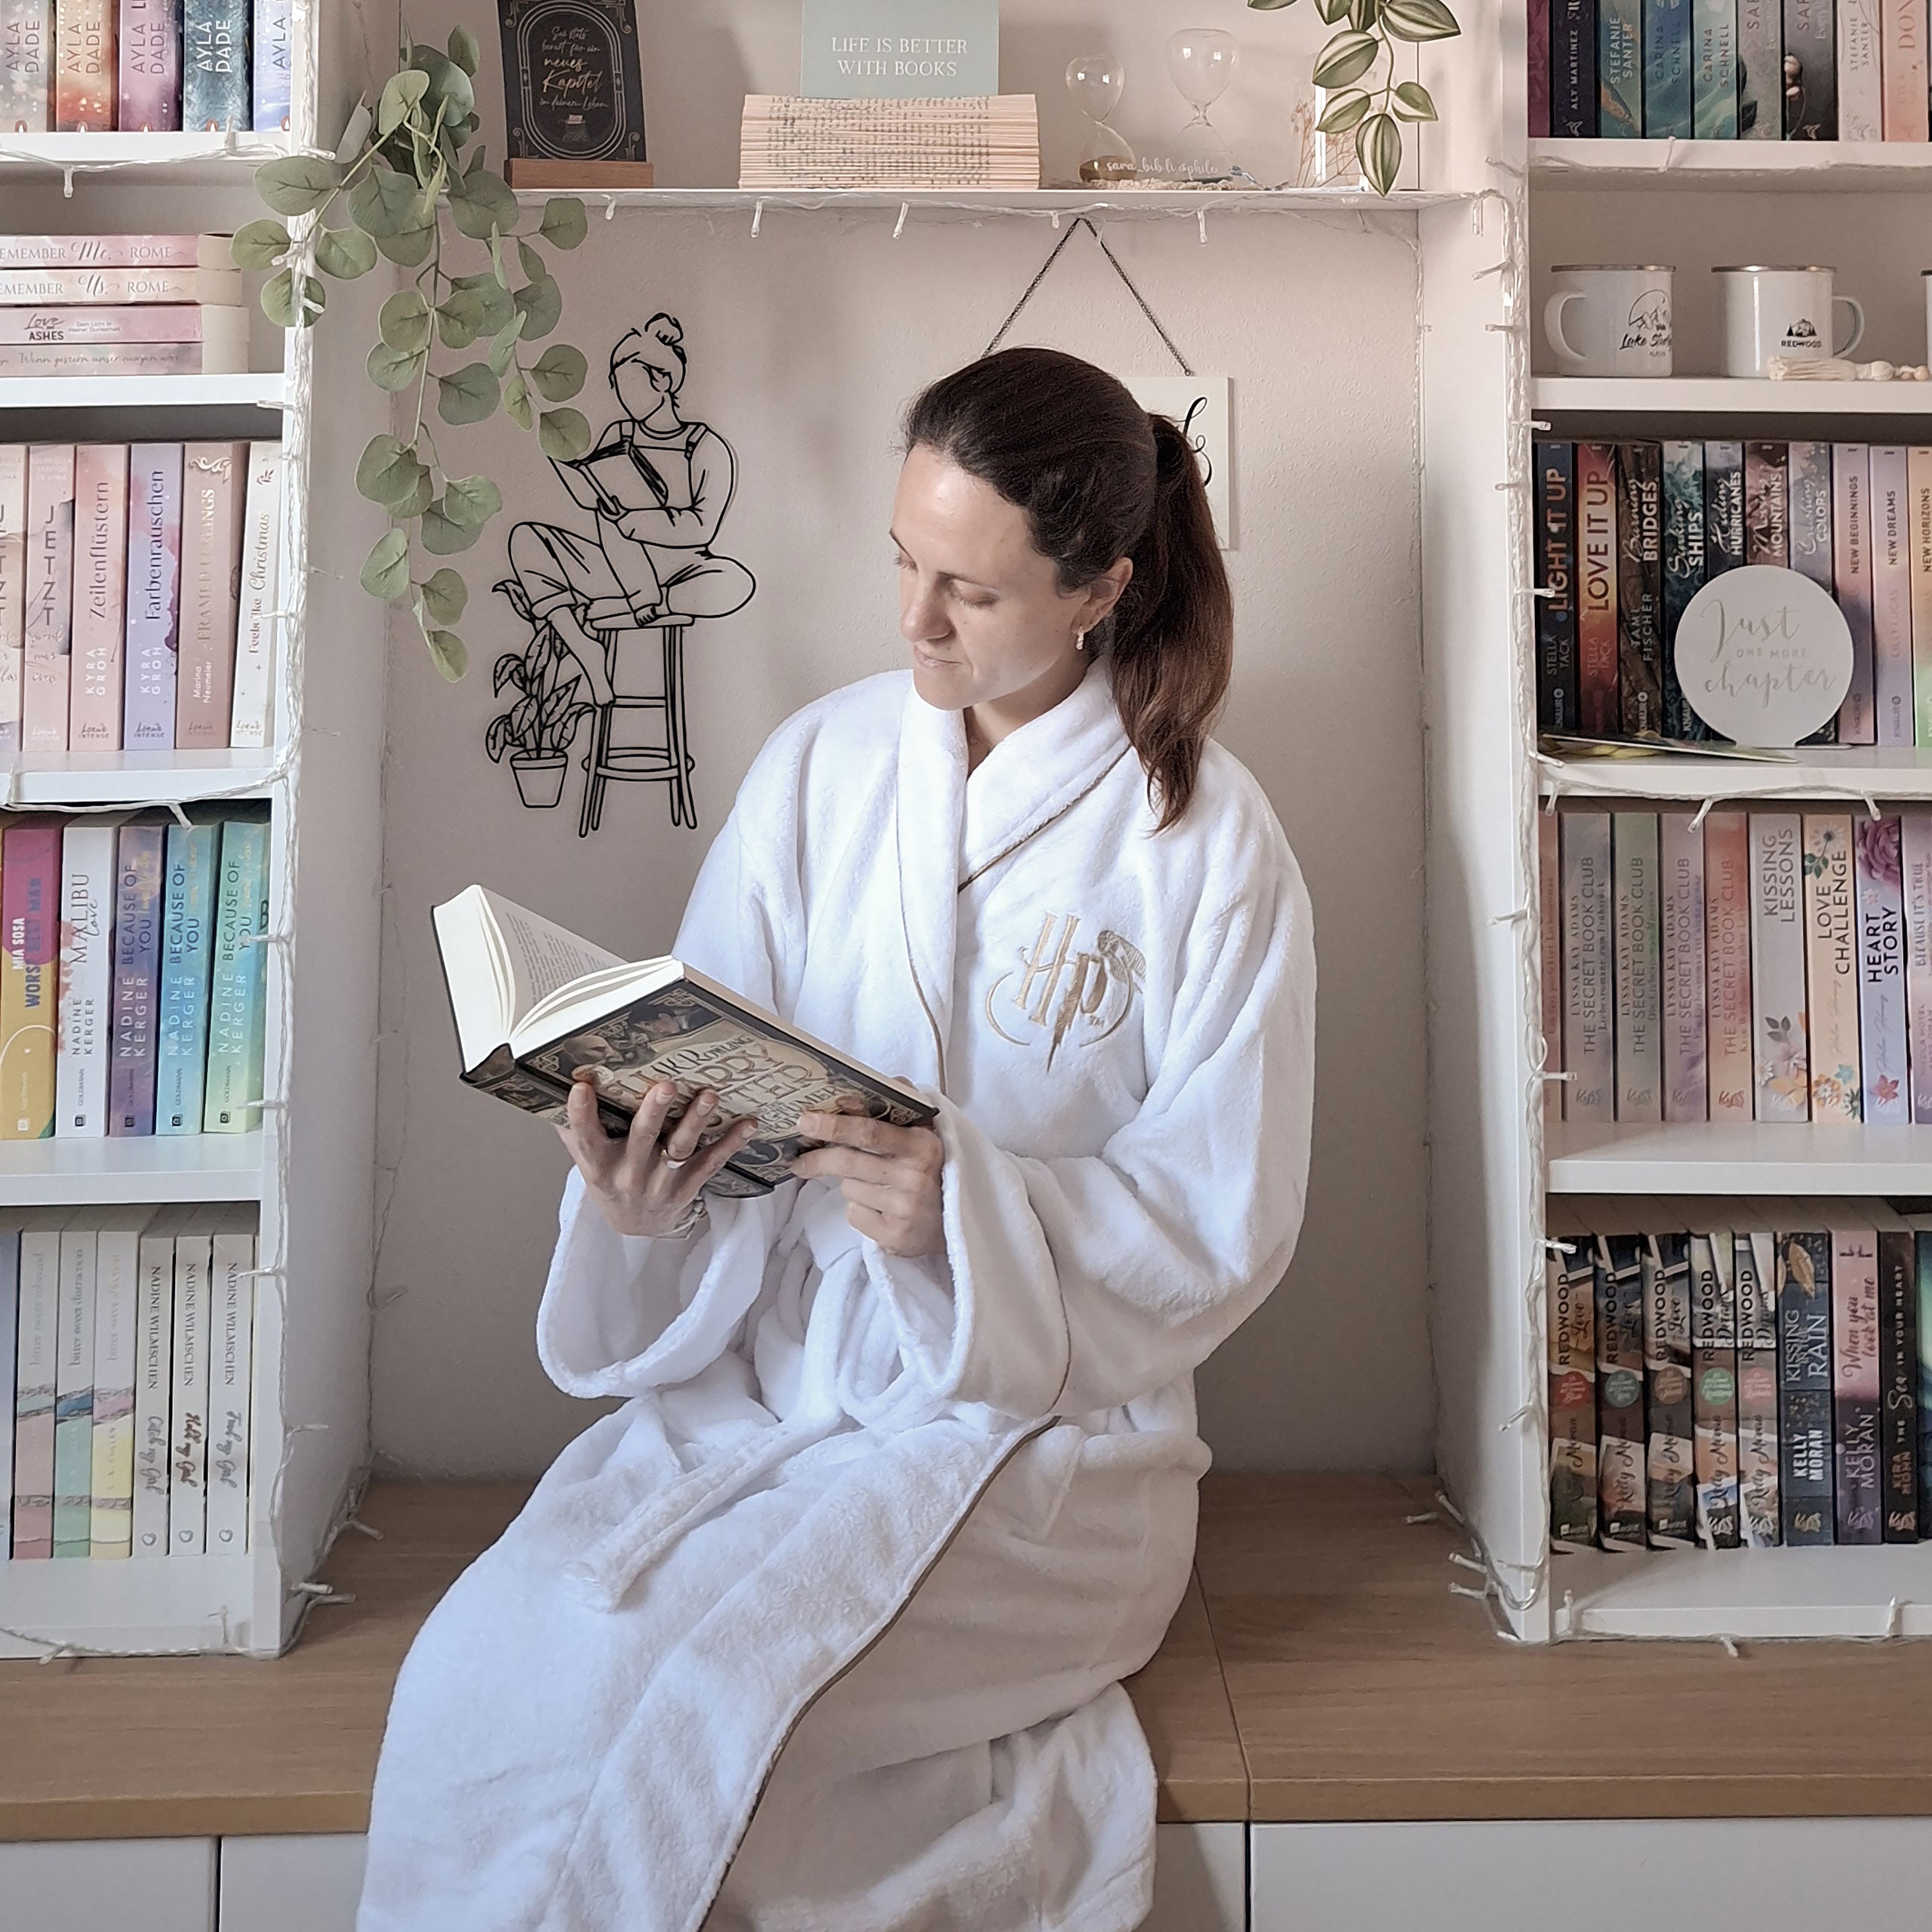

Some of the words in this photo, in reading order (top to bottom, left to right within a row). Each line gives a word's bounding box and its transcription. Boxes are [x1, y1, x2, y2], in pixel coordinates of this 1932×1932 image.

[5, 21, 20, 72] AYLA
[25, 20, 40, 72] DADE
[67, 23, 82, 73] AYLA
[86, 21, 100, 74] DADE
[131, 23, 145, 73] AYLA
[150, 22, 165, 74] DADE
[197, 20, 212, 73] AYLA
[216, 20, 232, 73] DADE
[272, 17, 286, 69] AYLA
[544, 58, 588, 72] neues
[832, 37, 869, 53] LIFE
[876, 38, 892, 53] IS
[900, 38, 968, 54] BETTER
[1570, 29, 1580, 92] MARTINEZ
[1610, 17, 1621, 85] STEFANIE
[1623, 23, 1634, 78] SANTER
[1654, 26, 1665, 79] CARINA
[1671, 22, 1681, 85] SCHNELL
[1703, 29, 1712, 82] CARINA
[1719, 25, 1729, 88] SCHNELL
[1861, 23, 1869, 66] SANTER
[543, 69, 603, 98] Kapitel
[837, 60, 887, 76] WITH
[894, 60, 957, 77] BOOKS
[1571, 94, 1579, 110] ALY
[0, 248, 66, 260] EMEMBER
[130, 246, 172, 259] ROME
[127, 280, 170, 293] ROME
[25, 313, 65, 330] Love
[29, 331, 64, 341] ASHES
[1546, 469, 1567, 500] UP
[1587, 470, 1608, 506] UP
[1587, 514, 1608, 534] IT
[1730, 471, 1743, 555] HURRICANES
[1770, 474, 1783, 557] MOUNTAINS
[1816, 490, 1827, 543] COLORS
[1849, 475, 1859, 545] BEGINNINGS
[1887, 491, 1897, 537] DREAMS
[1920, 488, 1930, 543] HORIZONS
[89, 481, 109, 620] Zeilenflüstern
[145, 470, 165, 620] Farbenrauschen
[249, 513, 270, 592] Christmas
[1664, 497, 1690, 579] Sinking
[1687, 512, 1704, 566] SHIPS
[1850, 549, 1860, 574] NEW
[1888, 540, 1898, 565] NEW
[1922, 547, 1931, 572] NEW
[43, 505, 57, 626] JETZT
[1546, 538, 1568, 611] LIGHT
[1587, 543, 1609, 611] LOVE
[249, 622, 260, 654] Feels
[1630, 608, 1641, 648] TAMI
[1642, 593, 1653, 662] FISCHER
[1701, 598, 1801, 664] Just
[85, 648, 96, 694] KYRA
[96, 648, 107, 695] GROH
[140, 648, 151, 694] KYRA
[152, 647, 162, 695] GROH
[1547, 635, 1557, 676] STELLA
[1737, 648, 1762, 658] ONE
[1770, 648, 1807, 658] MORE
[192, 666, 202, 699] Marina
[1705, 661, 1837, 709] chapter
[124, 865, 137, 888] OF
[172, 864, 185, 886] OF
[227, 861, 240, 883] OF
[1582, 857, 1594, 898] CLUB
[1631, 857, 1644, 900] CLUB
[1678, 858, 1690, 900] CLUB
[1721, 860, 1734, 901] CLUB
[1763, 835, 1778, 916] KISSING
[1778, 829, 1795, 923] LESSONS
[1912, 863, 1924, 891] TRUE
[12, 918, 25, 945] SOSA
[71, 874, 90, 964] MALIBU
[122, 894, 136, 964] BECAUSE
[139, 919, 151, 953] YOU
[170, 893, 185, 964] BECAUSE
[186, 918, 199, 953] YOU
[223, 890, 238, 961] BECAUSE
[1571, 895, 1579, 937] ADAMS
[1583, 906, 1595, 952] BOOK
[1632, 905, 1644, 952] BOOK
[1678, 906, 1690, 952] BOOK
[1722, 906, 1734, 955] BOOK
[1816, 884, 1832, 939] LOVE
[1832, 850, 1850, 974] CHALLENGE
[12, 949, 25, 970] MIA
[1571, 947, 1580, 971] KAY
[1866, 912, 1882, 983] HEART
[1883, 906, 1898, 976] STORY
[1915, 920, 1927, 967] BECAUSE
[218, 973, 233, 1053] NADINE
[231, 974, 247, 1054] KERGER
[1571, 977, 1580, 1015] LYSSA
[1583, 960, 1595, 1019] SECRET
[1632, 959, 1644, 1020] SECRET
[1679, 960, 1690, 1019] SECRET
[1723, 961, 1736, 1020] SECRET
[72, 998, 82, 1055] NADINE
[84, 998, 94, 1055] KERGER
[119, 977, 134, 1056] NADINE
[134, 977, 148, 1057] KERGER
[168, 976, 183, 1056] NADINE
[181, 977, 195, 1056] KERGER
[1584, 1025, 1595, 1054] THE
[1633, 1027, 1644, 1054] THE
[1680, 1025, 1691, 1054] THE
[1724, 1026, 1736, 1056] THE
[150, 1266, 162, 1312] NADINE
[186, 1263, 196, 1310] NADINE
[227, 1262, 238, 1309] NADINE
[1847, 1297, 1868, 1324] you
[1864, 1276, 1875, 1300] me
[1894, 1265, 1904, 1306] HEART
[1558, 1274, 1570, 1365] REDWOOD
[1605, 1272, 1618, 1364] REDWOOD
[1655, 1269, 1667, 1361] REDWOOD
[1701, 1270, 1715, 1361] REDWOOD
[1741, 1270, 1755, 1361] REDWOOD
[1861, 1304, 1875, 1321] at
[1895, 1312, 1905, 1346] YOUR
[148, 1315, 160, 1389] WILMSCHEN
[184, 1312, 195, 1386] WILMSCHEN
[225, 1311, 236, 1386] WILMSCHEN
[1785, 1309, 1801, 1383] KISSING
[1807, 1314, 1828, 1378] RAIN
[1839, 1330, 1863, 1378] When
[1861, 1326, 1876, 1358] look
[1896, 1352, 1905, 1366] IN
[139, 1448, 155, 1463] my
[1793, 1433, 1807, 1478] KELLY
[1808, 1430, 1824, 1481] MORAN
[1845, 1424, 1860, 1478] KELLY
[1858, 1414, 1875, 1489] MORAN
[1892, 1453, 1903, 1489] KIRA
